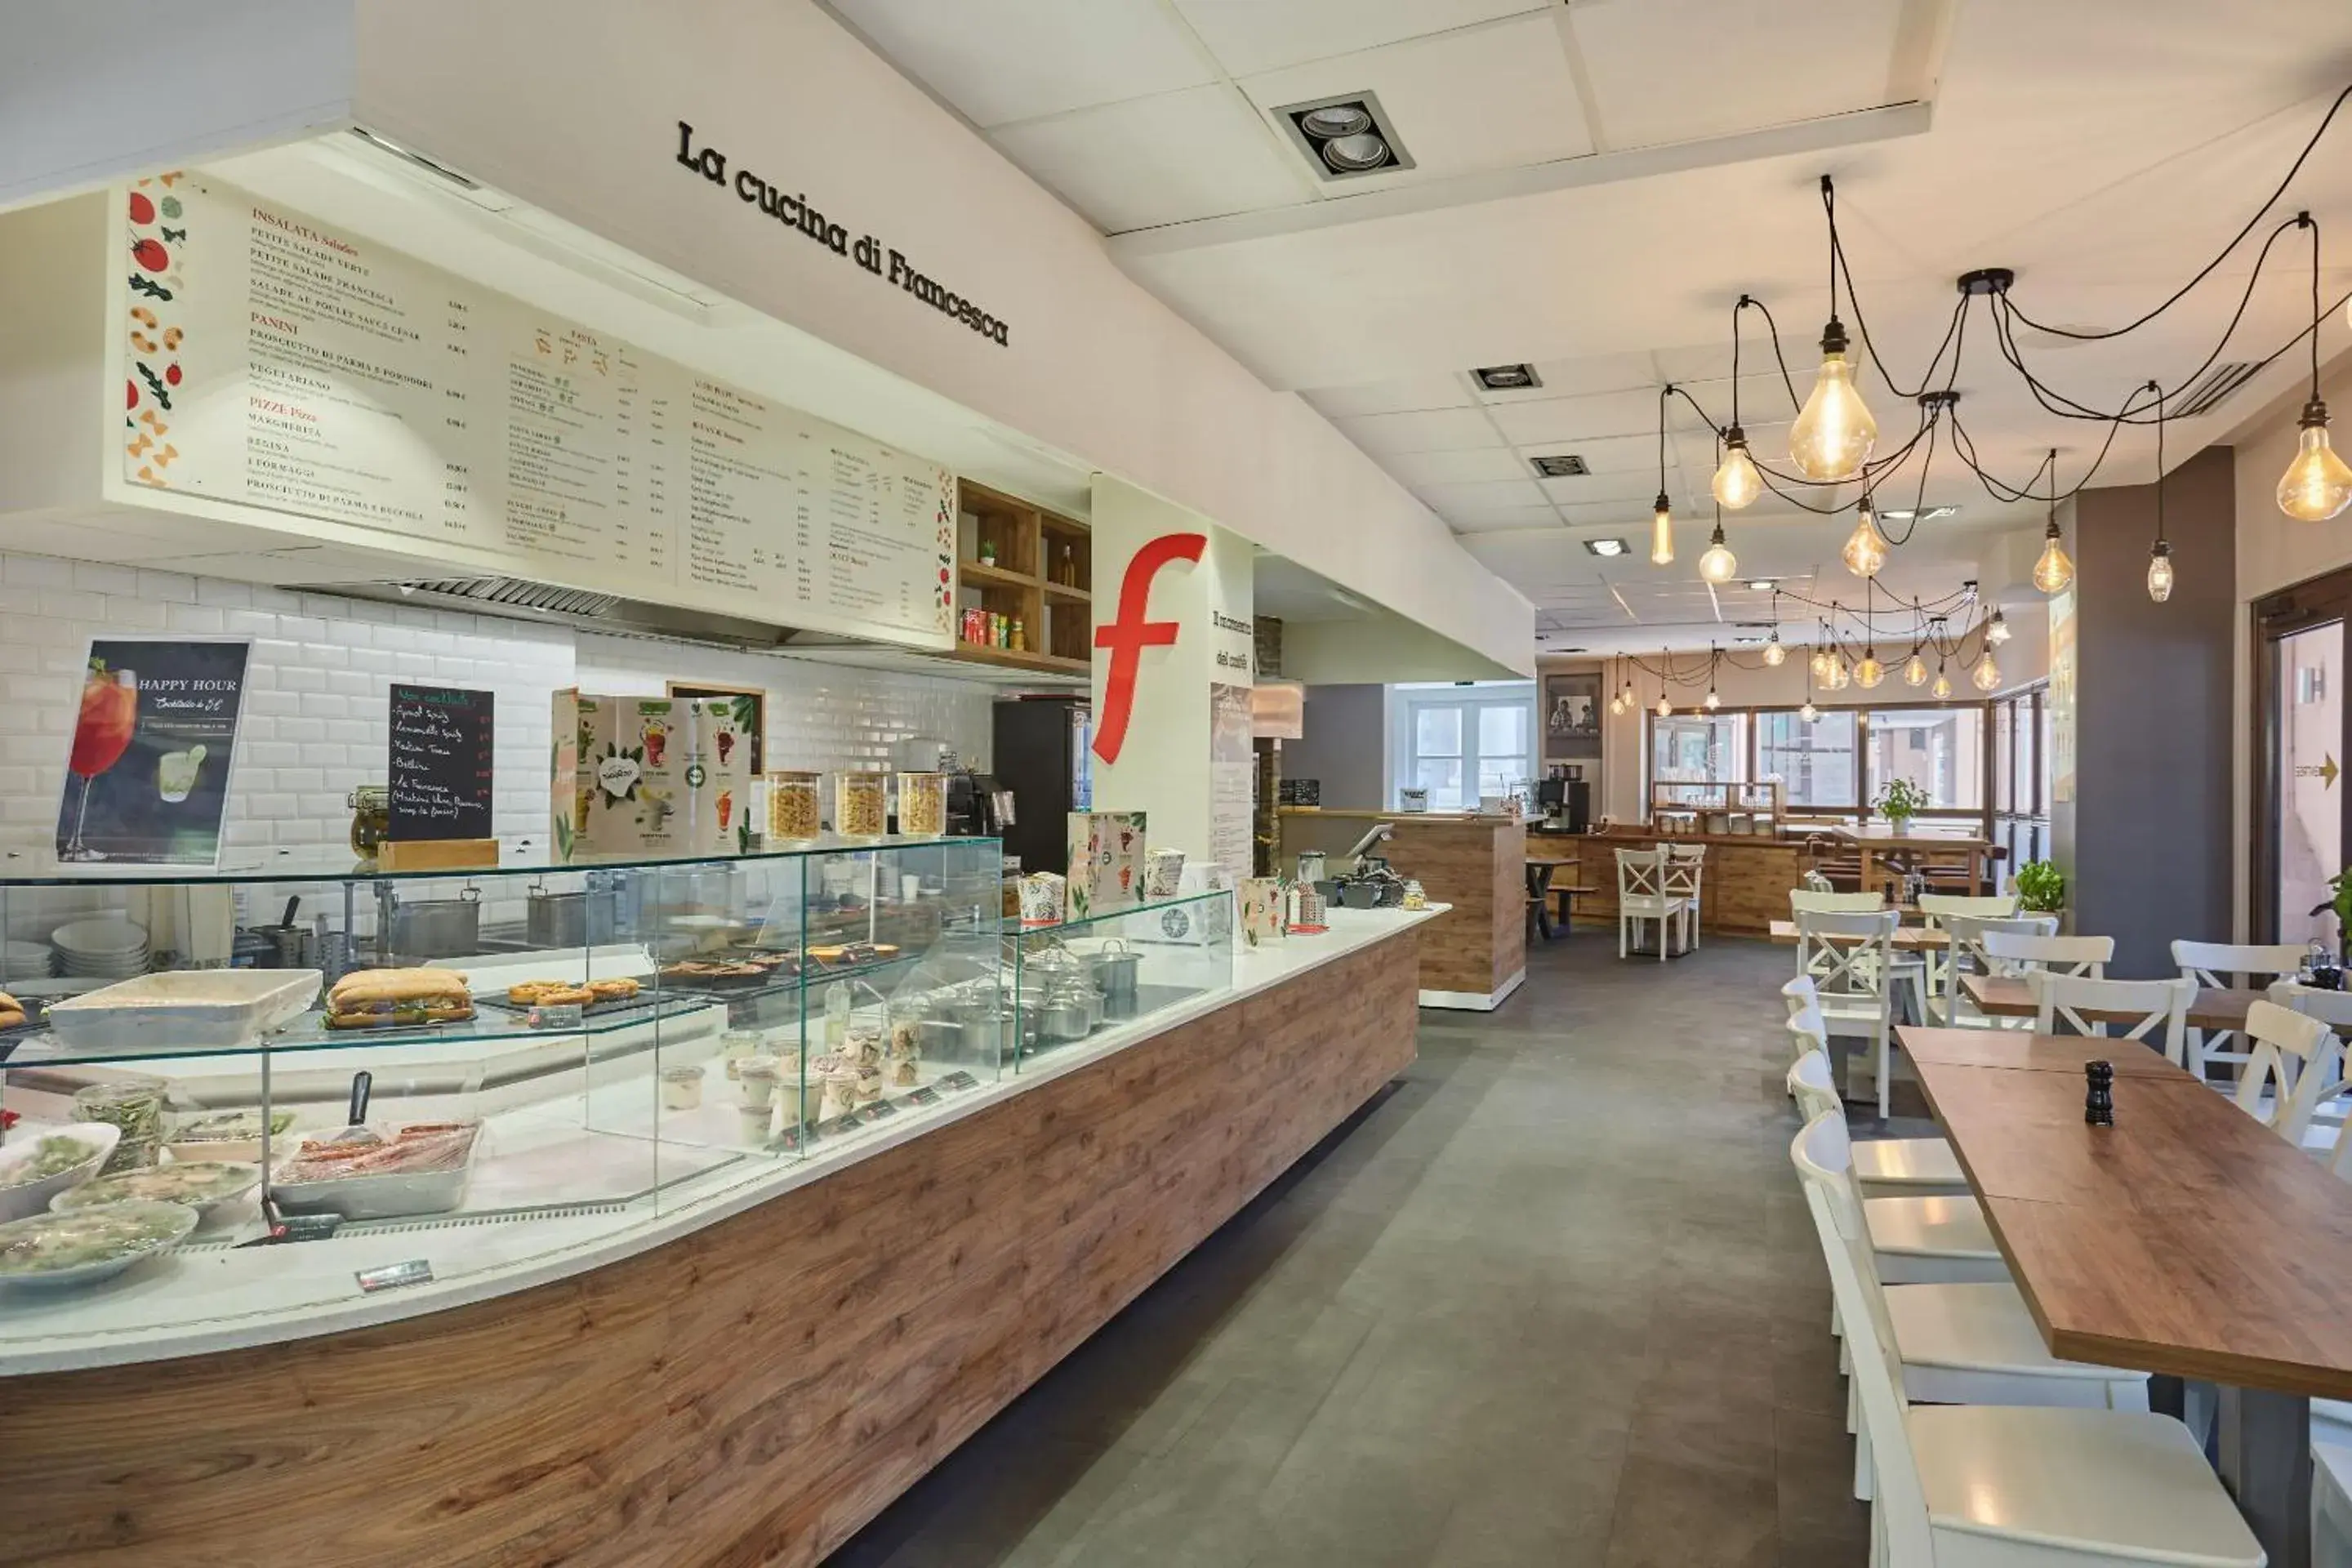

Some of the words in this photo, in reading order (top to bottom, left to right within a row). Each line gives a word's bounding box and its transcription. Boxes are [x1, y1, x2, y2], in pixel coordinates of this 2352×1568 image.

[252, 207, 318, 243] INSALATA
[676, 120, 727, 187] La
[735, 170, 848, 256] cucina
[853, 234, 882, 275] di
[887, 248, 1009, 347] Francesca
[251, 311, 298, 335] PANINI
[250, 328, 318, 355] PROSCIUTTO
[1091, 532, 1208, 765] f
[139, 679, 189, 691] HAPPY
[193, 679, 236, 691] HOUR
